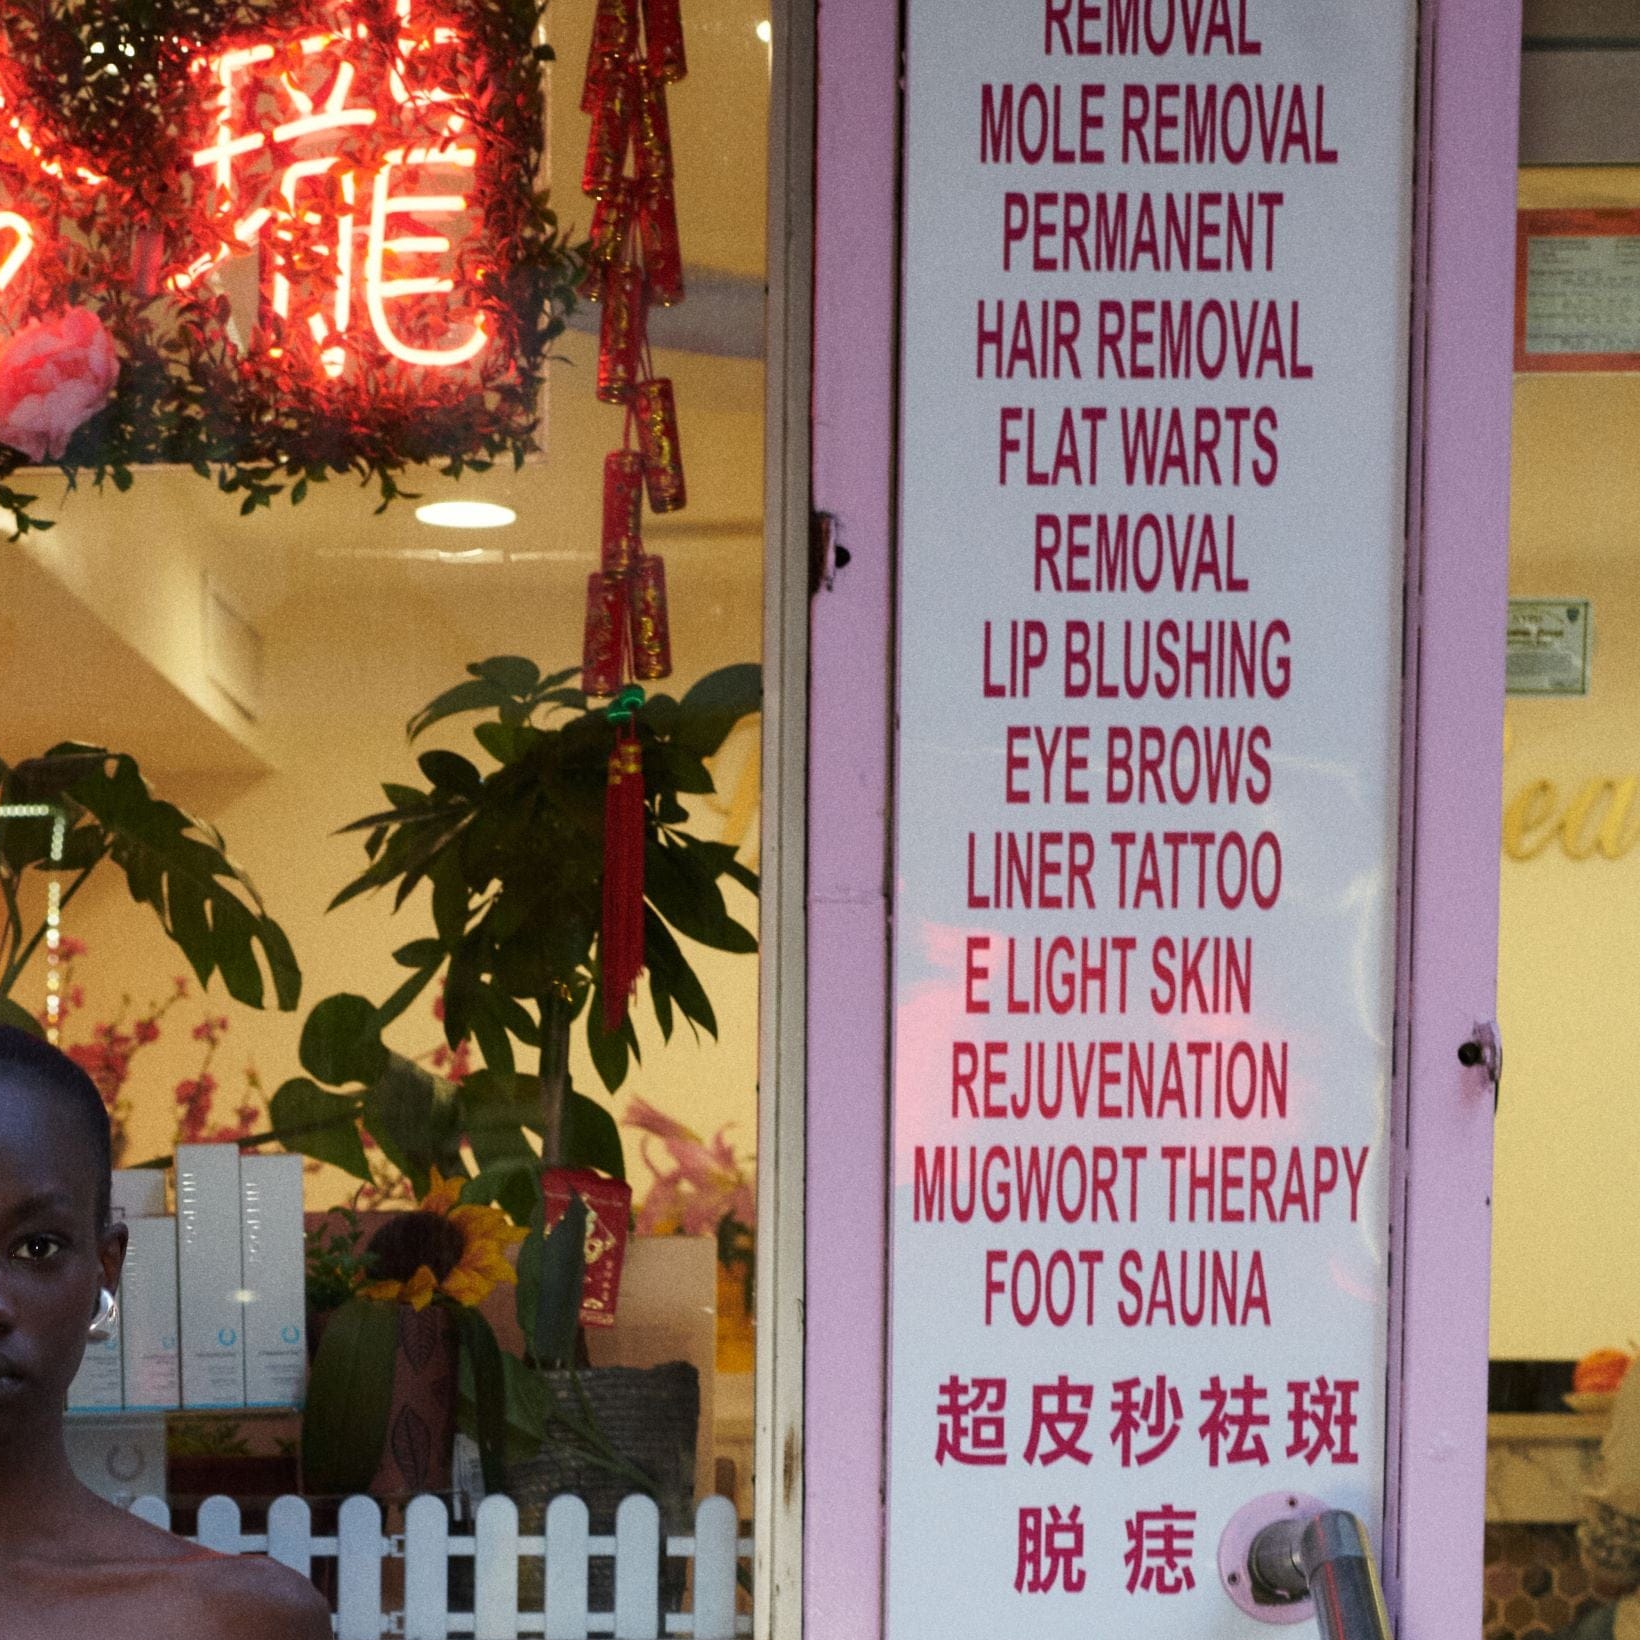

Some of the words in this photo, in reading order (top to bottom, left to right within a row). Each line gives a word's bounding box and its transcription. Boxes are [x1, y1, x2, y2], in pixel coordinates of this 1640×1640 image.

[1045, 0, 1261, 56] REMOVAL
[981, 83, 1105, 165] MOLE
[1122, 84, 1338, 164] REMOVAL
[1003, 192, 1284, 272] PERMANENT
[977, 300, 1080, 378] HAIR
[1098, 299, 1313, 380] REMOVAL
[999, 407, 1107, 486] FLAT
[1120, 406, 1278, 487] WARTS
[1034, 513, 1249, 593] REMOVAL
[983, 619, 1048, 698] LIP
[1064, 619, 1291, 699] BLUSHING
[1005, 726, 1090, 804] EYE
[1106, 725, 1272, 805] BROWS
[967, 831, 1096, 909] LINER
[1110, 830, 1282, 910] TATTOO
[965, 936, 991, 1014] E
[1007, 935, 1137, 1015] LIGHT
[1150, 936, 1252, 1015] SKIN
[952, 1041, 1288, 1119] REJUVENATION
[913, 1145, 1148, 1223] MUGWORT
[1161, 1146, 1369, 1222] THERAPY
[985, 1249, 1104, 1327] FOOT
[1118, 1249, 1271, 1327] SAUNA
